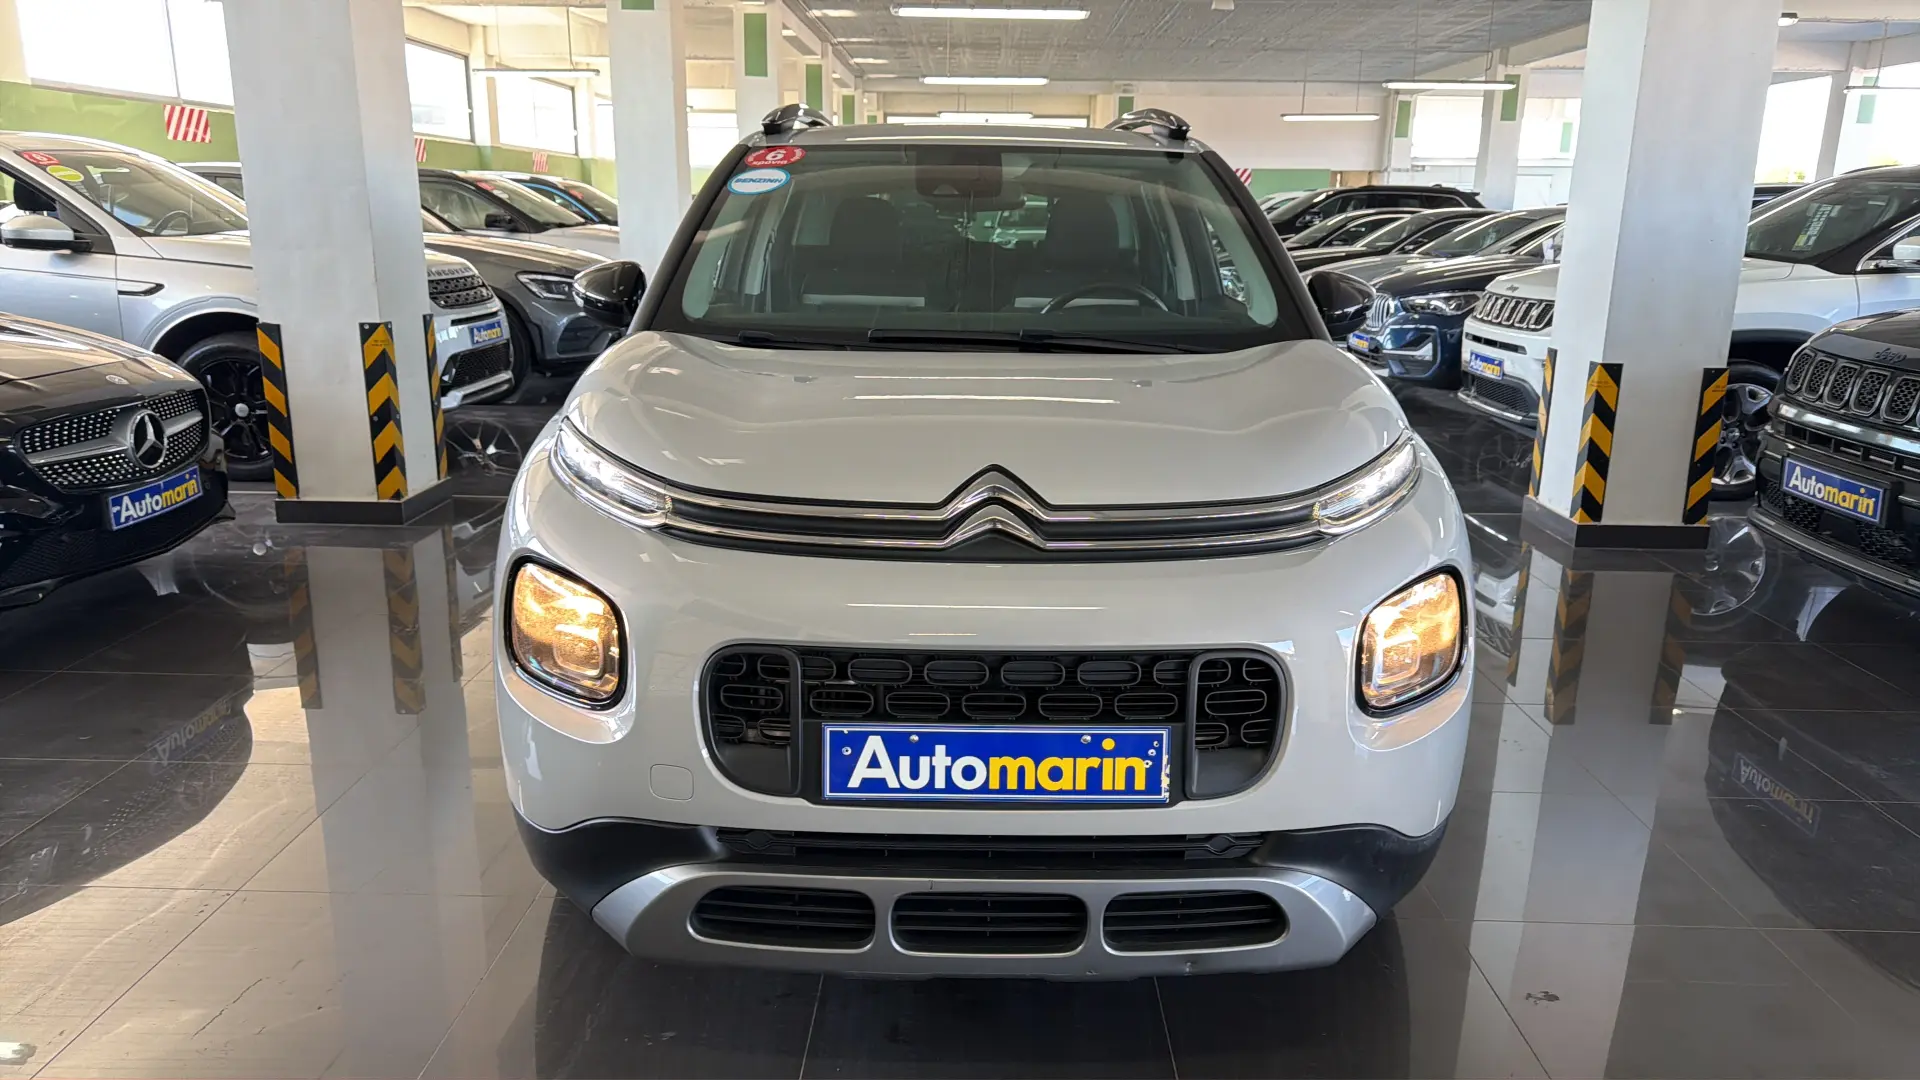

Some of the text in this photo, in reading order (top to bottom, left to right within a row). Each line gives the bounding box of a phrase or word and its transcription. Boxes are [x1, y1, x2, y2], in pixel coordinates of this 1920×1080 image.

[765, 149, 787, 161] 6
[119, 473, 199, 523] Automarin
[1788, 465, 1876, 517] Automarin
[847, 735, 1147, 792] Automarin
